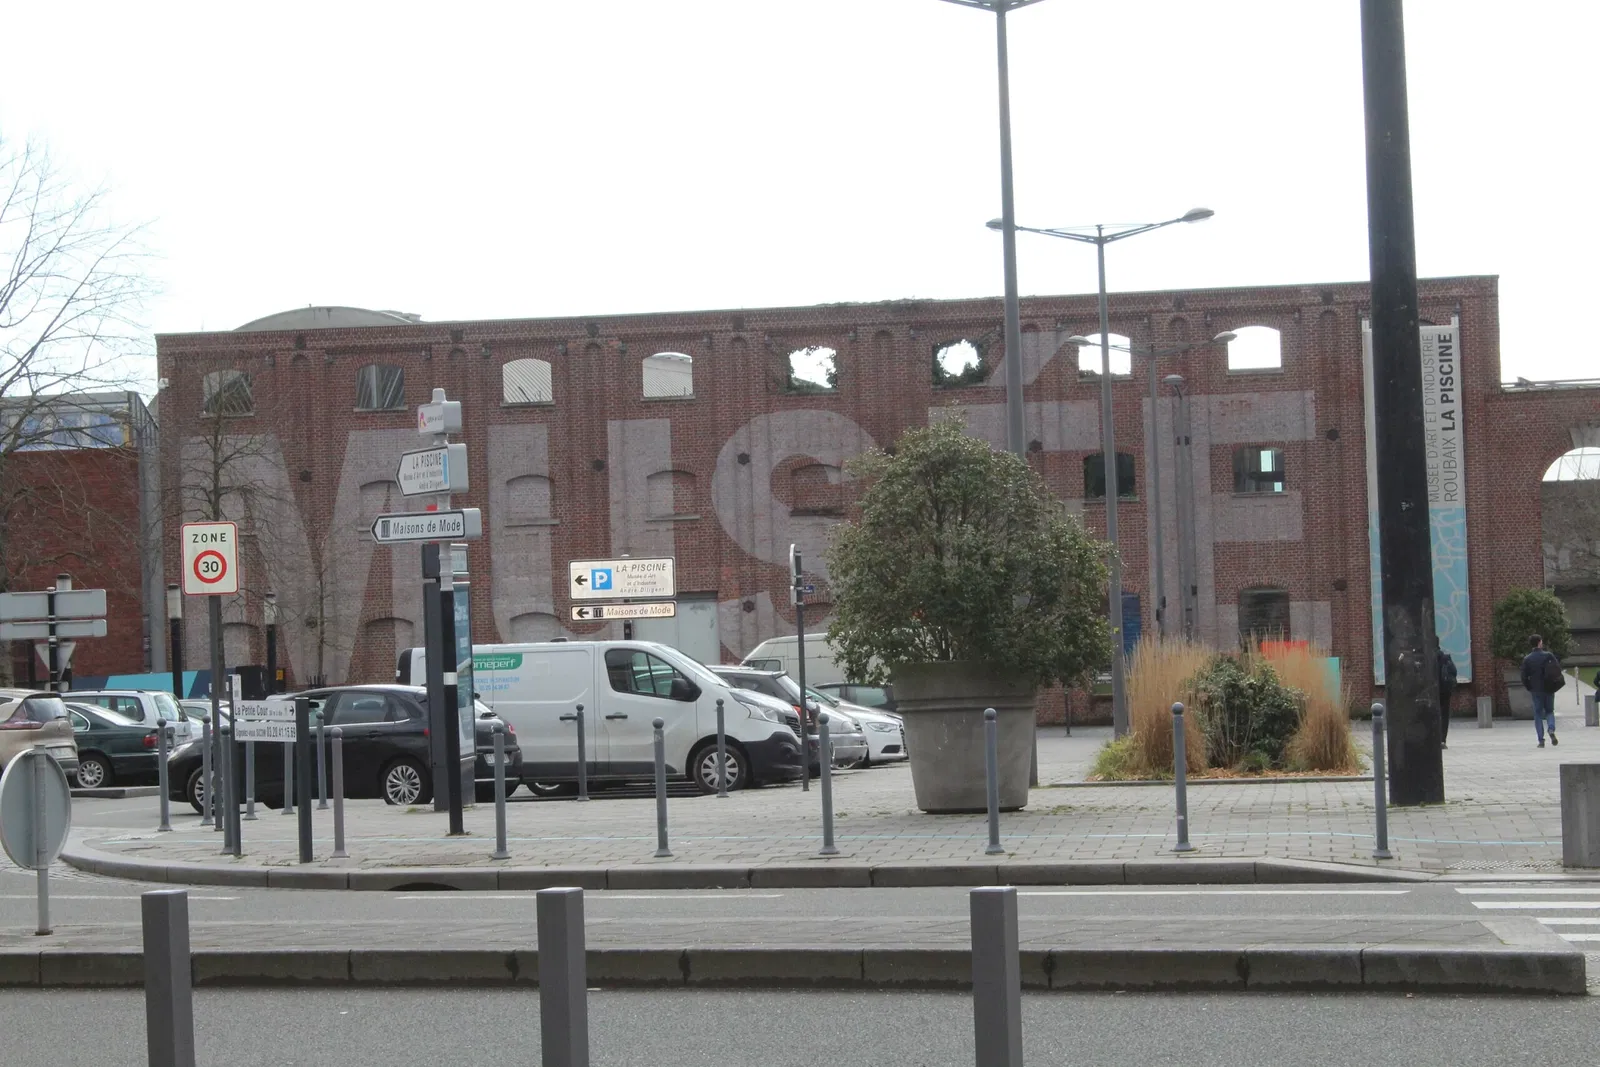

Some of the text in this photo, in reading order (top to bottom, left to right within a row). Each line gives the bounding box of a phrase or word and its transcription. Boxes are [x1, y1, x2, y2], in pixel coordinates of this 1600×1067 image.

[1422, 335, 1436, 406] D'INDUSTRIE
[1425, 410, 1437, 423] ET
[1438, 333, 1458, 502] ROUBAIX LA PISCINE
[1426, 427, 1438, 458] D'ART
[412, 452, 442, 470] LA PISCINE
[393, 518, 460, 534] Maisons de Mode
[192, 532, 226, 543] ZONE
[202, 561, 219, 572] 30
[632, 562, 666, 572] PISCINE
[595, 572, 608, 588] P
[606, 607, 638, 616] Maisons
[650, 606, 671, 615] Mode
[473, 658, 516, 669] meperf
[235, 705, 240, 716] La
[242, 704, 256, 716] Petite
[257, 704, 268, 716] Cour
